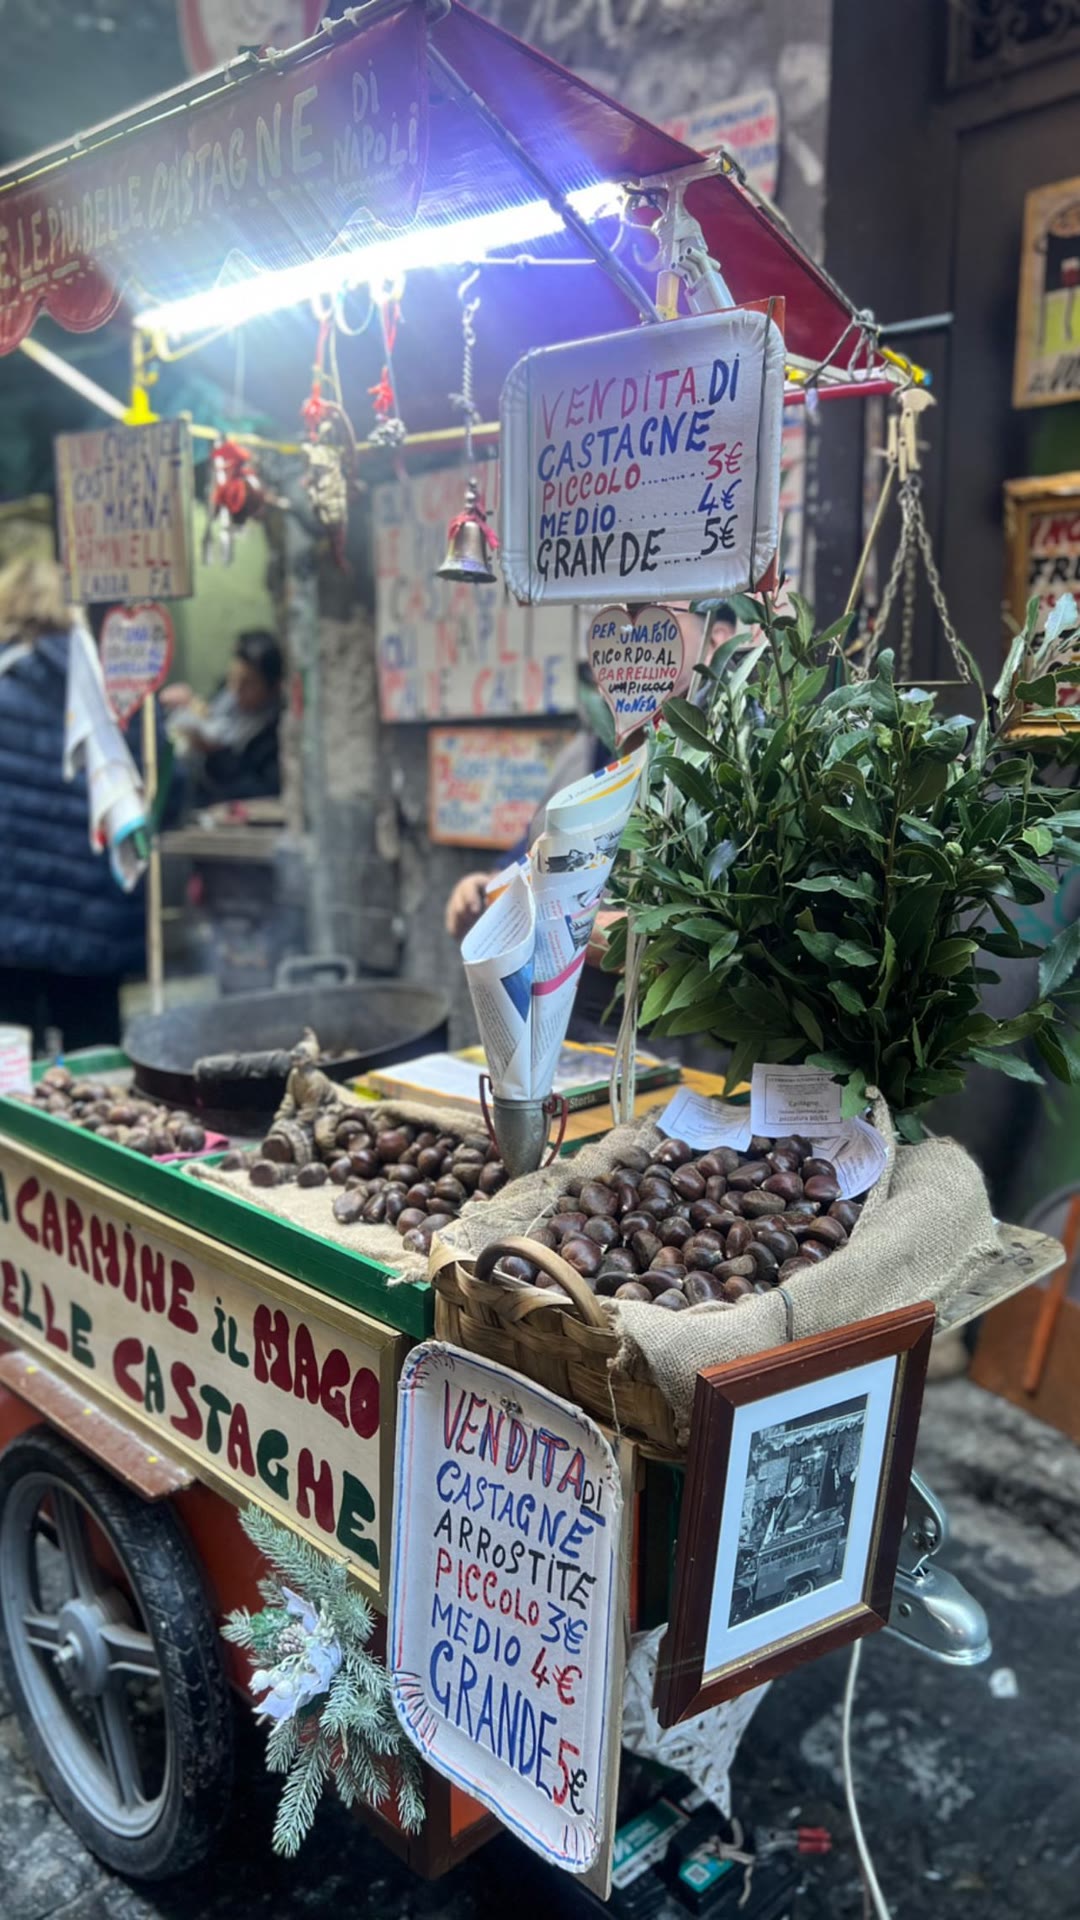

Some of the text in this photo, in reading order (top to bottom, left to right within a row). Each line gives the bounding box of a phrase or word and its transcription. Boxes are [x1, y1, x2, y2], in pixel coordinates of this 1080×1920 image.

[537, 409, 716, 482] CASTAGNE
[592, 621, 616, 640] PER
[598, 666, 677, 682] CARRELLINO
[655, 647, 676, 666] AL
[615, 695, 657, 713] MONETA
[253, 1303, 380, 1440] MAGO
[444, 1379, 585, 1501] VENDITA
[433, 1508, 597, 1610] ARROSTITE
[436, 1460, 594, 1559] CASTAGNE
[431, 1593, 583, 1706] MEDIO 4€
[435, 1547, 588, 1655] PICCOLO 3€
[429, 1639, 588, 1816] GRANDE 5€
